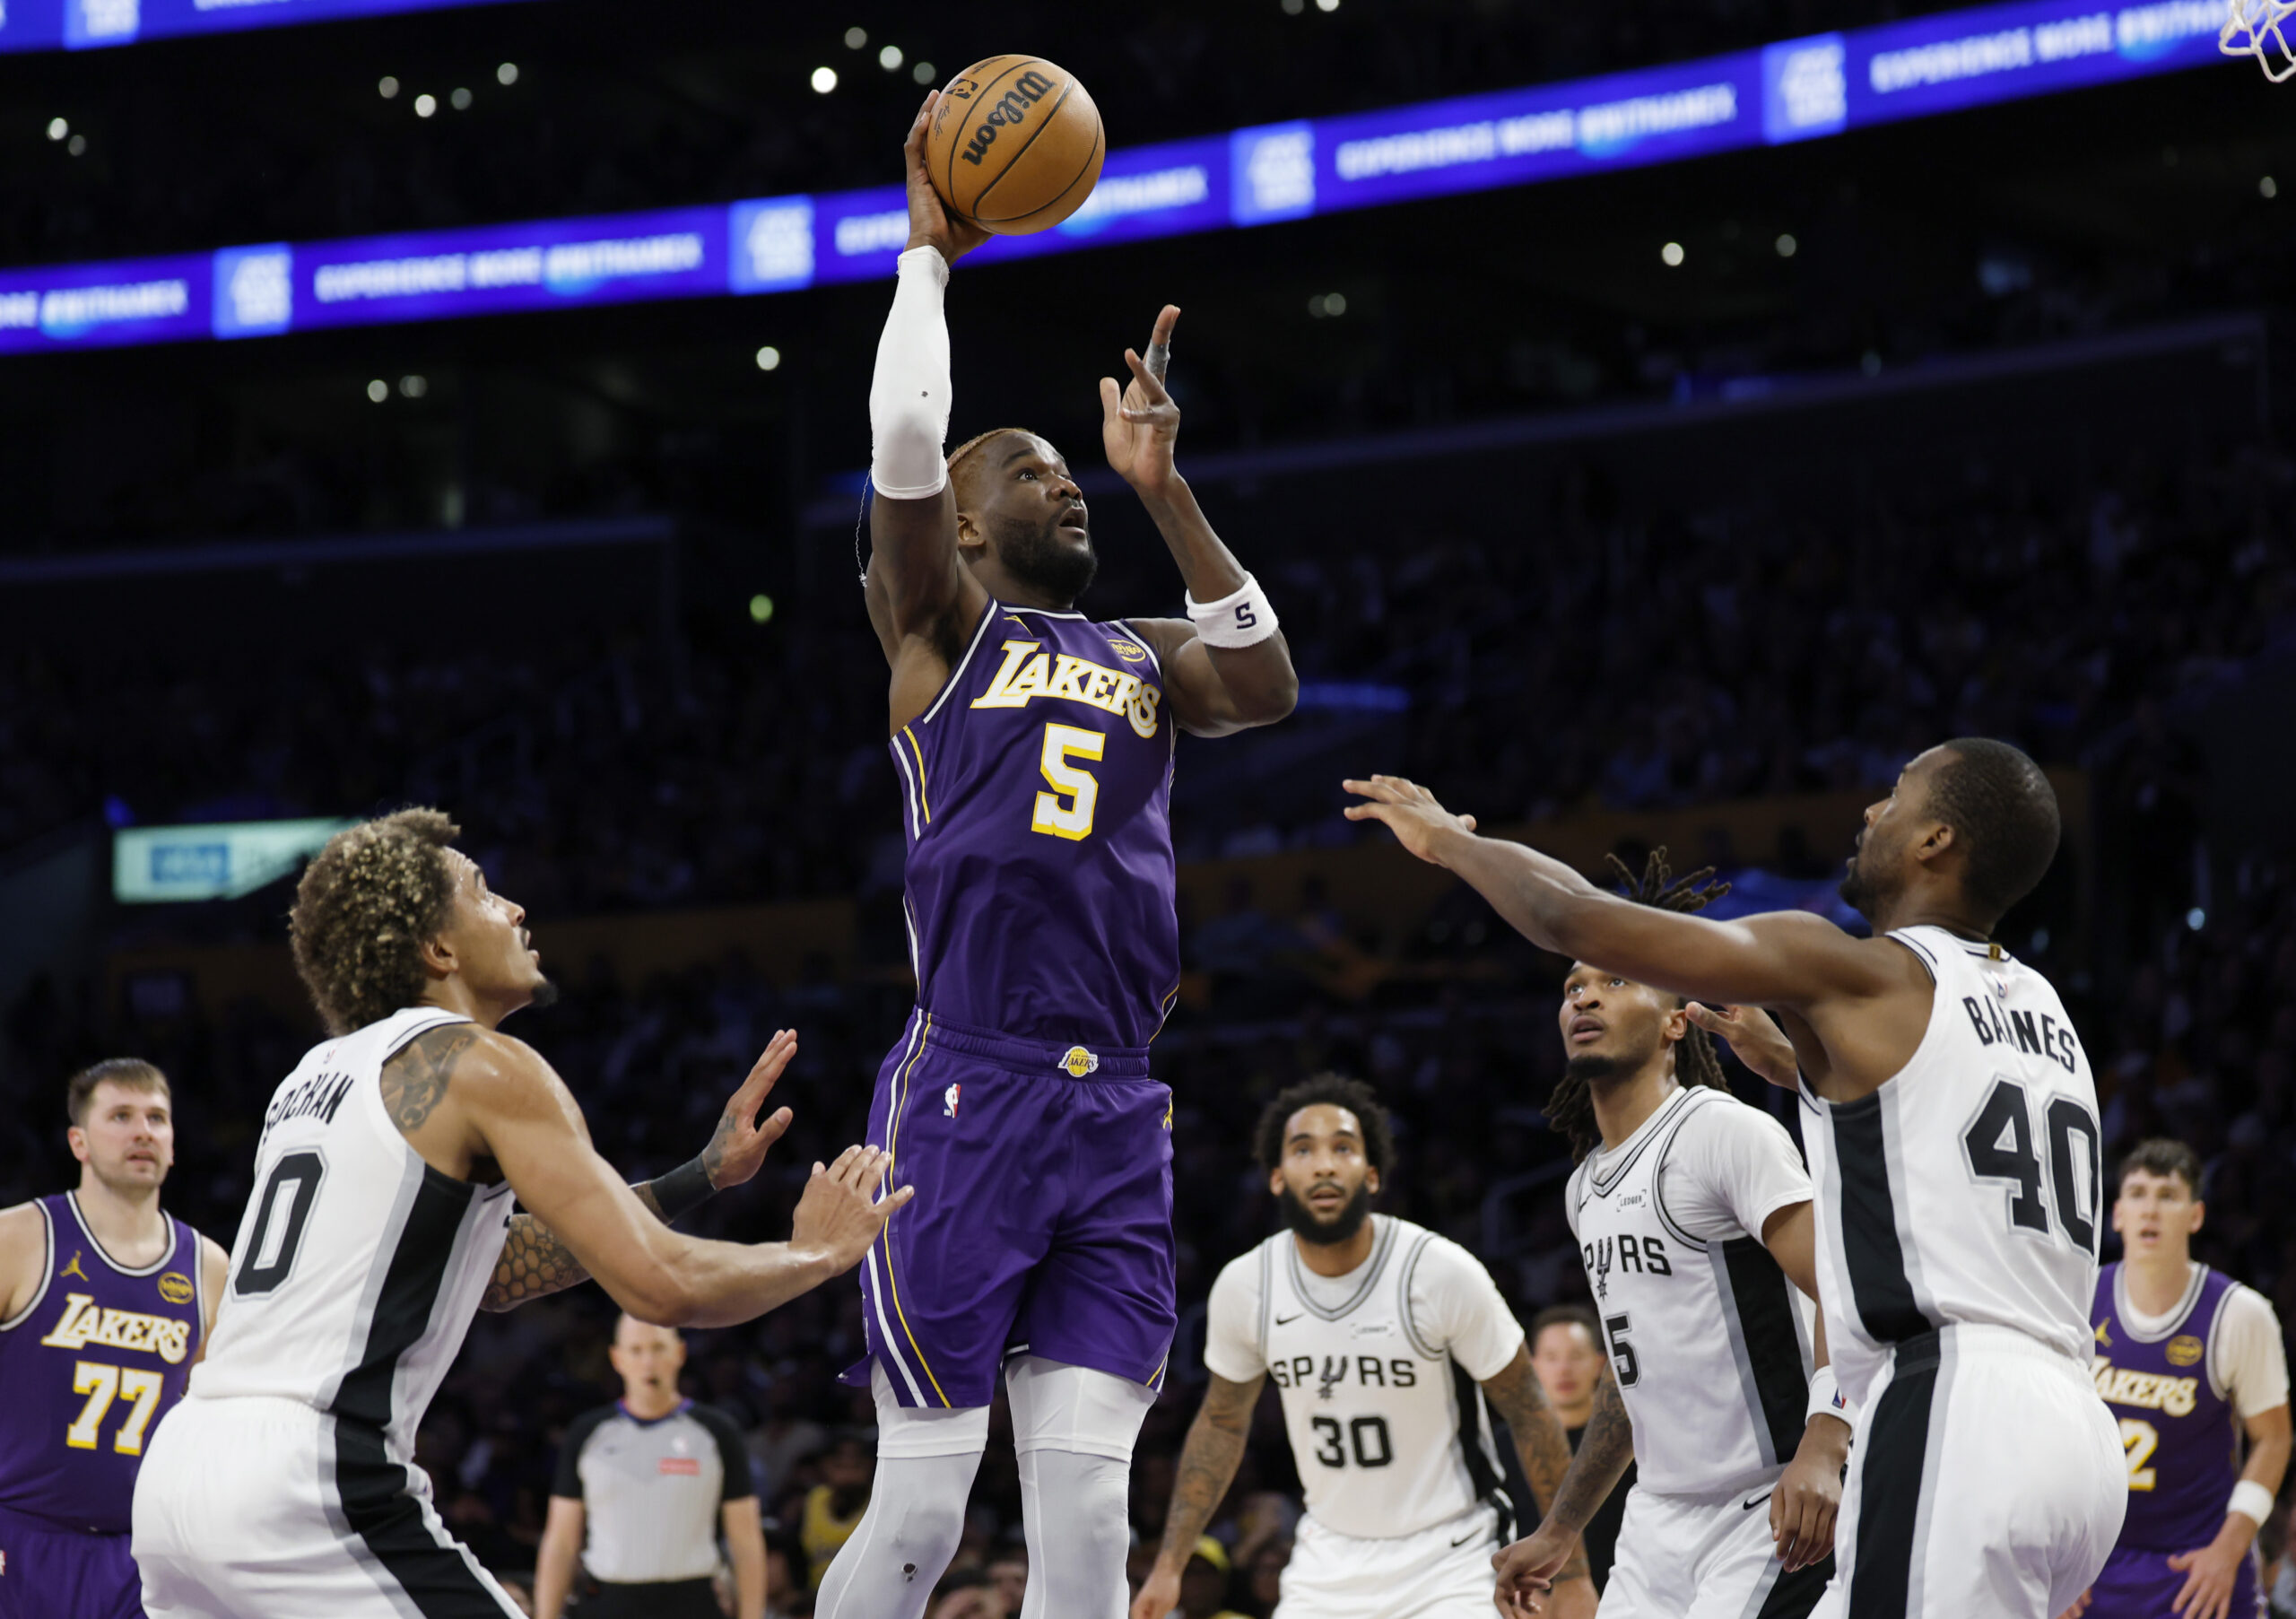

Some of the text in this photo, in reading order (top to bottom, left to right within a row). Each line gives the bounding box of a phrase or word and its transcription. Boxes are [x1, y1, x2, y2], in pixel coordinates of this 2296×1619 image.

[961, 71, 1057, 165] Wilson
[970, 640, 1161, 738] LAKERS
[1031, 722, 1106, 841] 5
[1958, 1073, 2101, 1266] 40
[231, 1145, 329, 1303] 0
[1584, 1233, 1673, 1301] PURS
[41, 1293, 191, 1364] LAKERS
[1604, 1310, 1641, 1390] 5
[66, 1360, 164, 1456] 77
[1273, 1355, 1416, 1400] SPURS
[1311, 1414, 1394, 1469] 30
